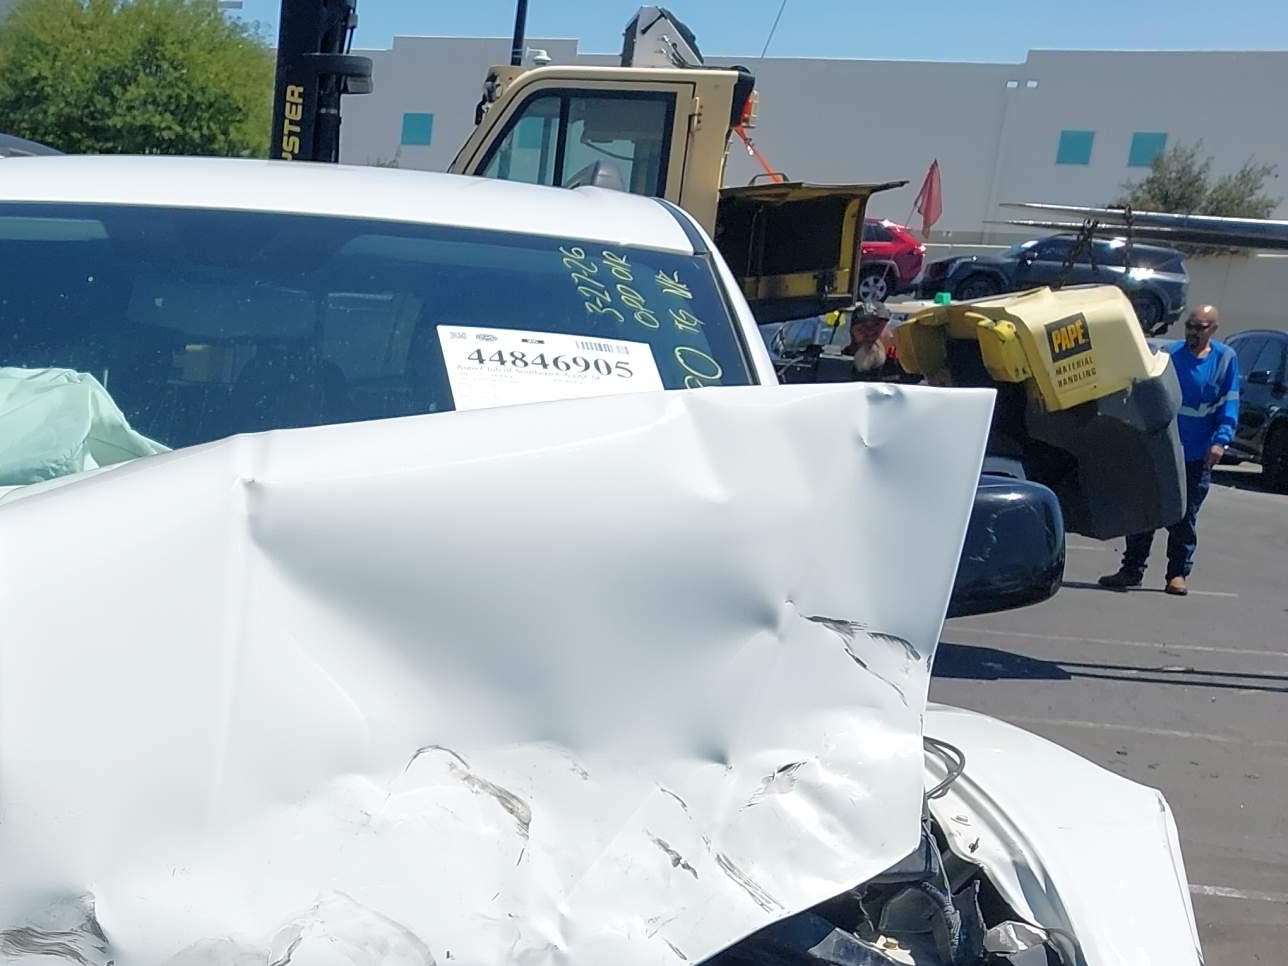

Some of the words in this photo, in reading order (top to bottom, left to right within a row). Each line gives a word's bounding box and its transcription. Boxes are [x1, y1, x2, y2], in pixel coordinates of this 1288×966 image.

[467, 348, 634, 379] 44846905
[1055, 356, 1094, 375] MATERIAL
[1058, 367, 1097, 388] HANDLING
